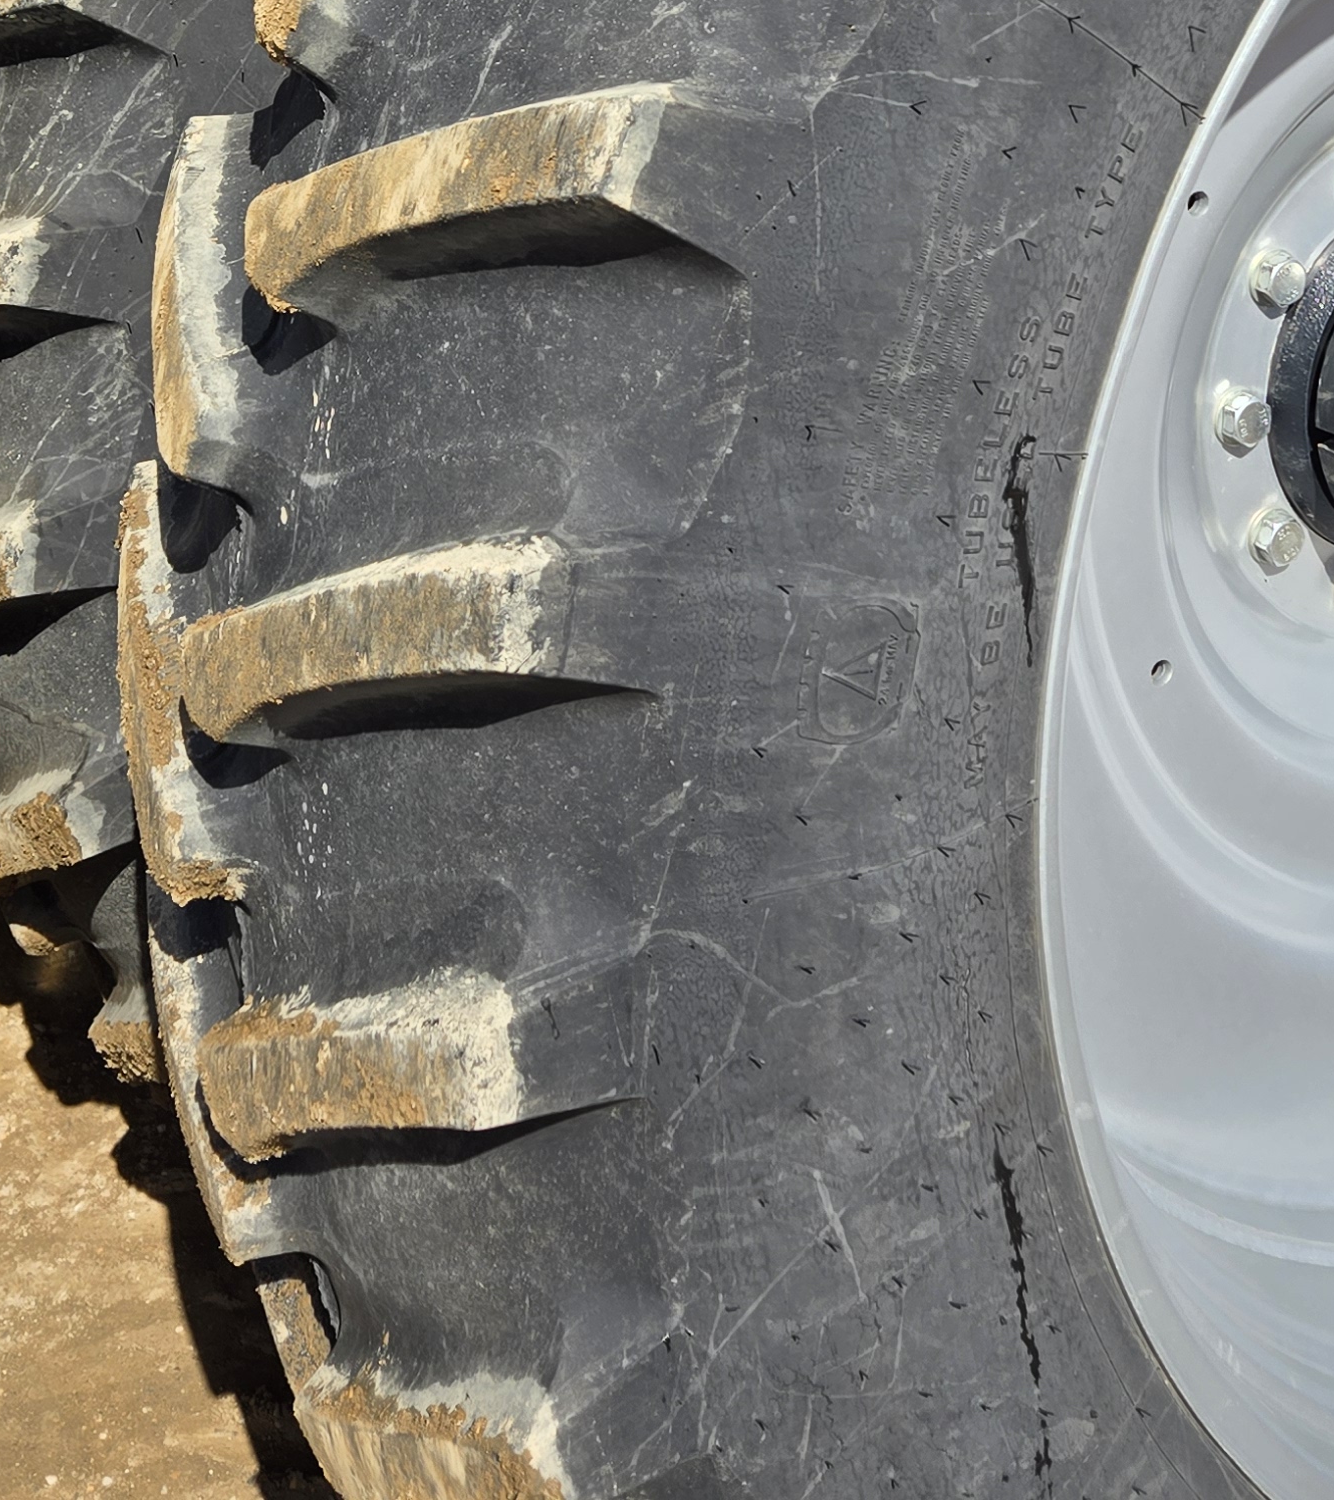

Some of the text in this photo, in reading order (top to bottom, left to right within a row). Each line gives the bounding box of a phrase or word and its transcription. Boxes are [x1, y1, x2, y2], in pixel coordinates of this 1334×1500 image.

[838, 441, 865, 514] SAFETY
[857, 337, 900, 427] WARNING:
[957, 316, 1041, 588] TUBELESS
[964, 701, 992, 790] MAY
[980, 601, 1009, 667] BE
[1033, 272, 1089, 401] TUBE
[1084, 122, 1147, 240] TYPE
